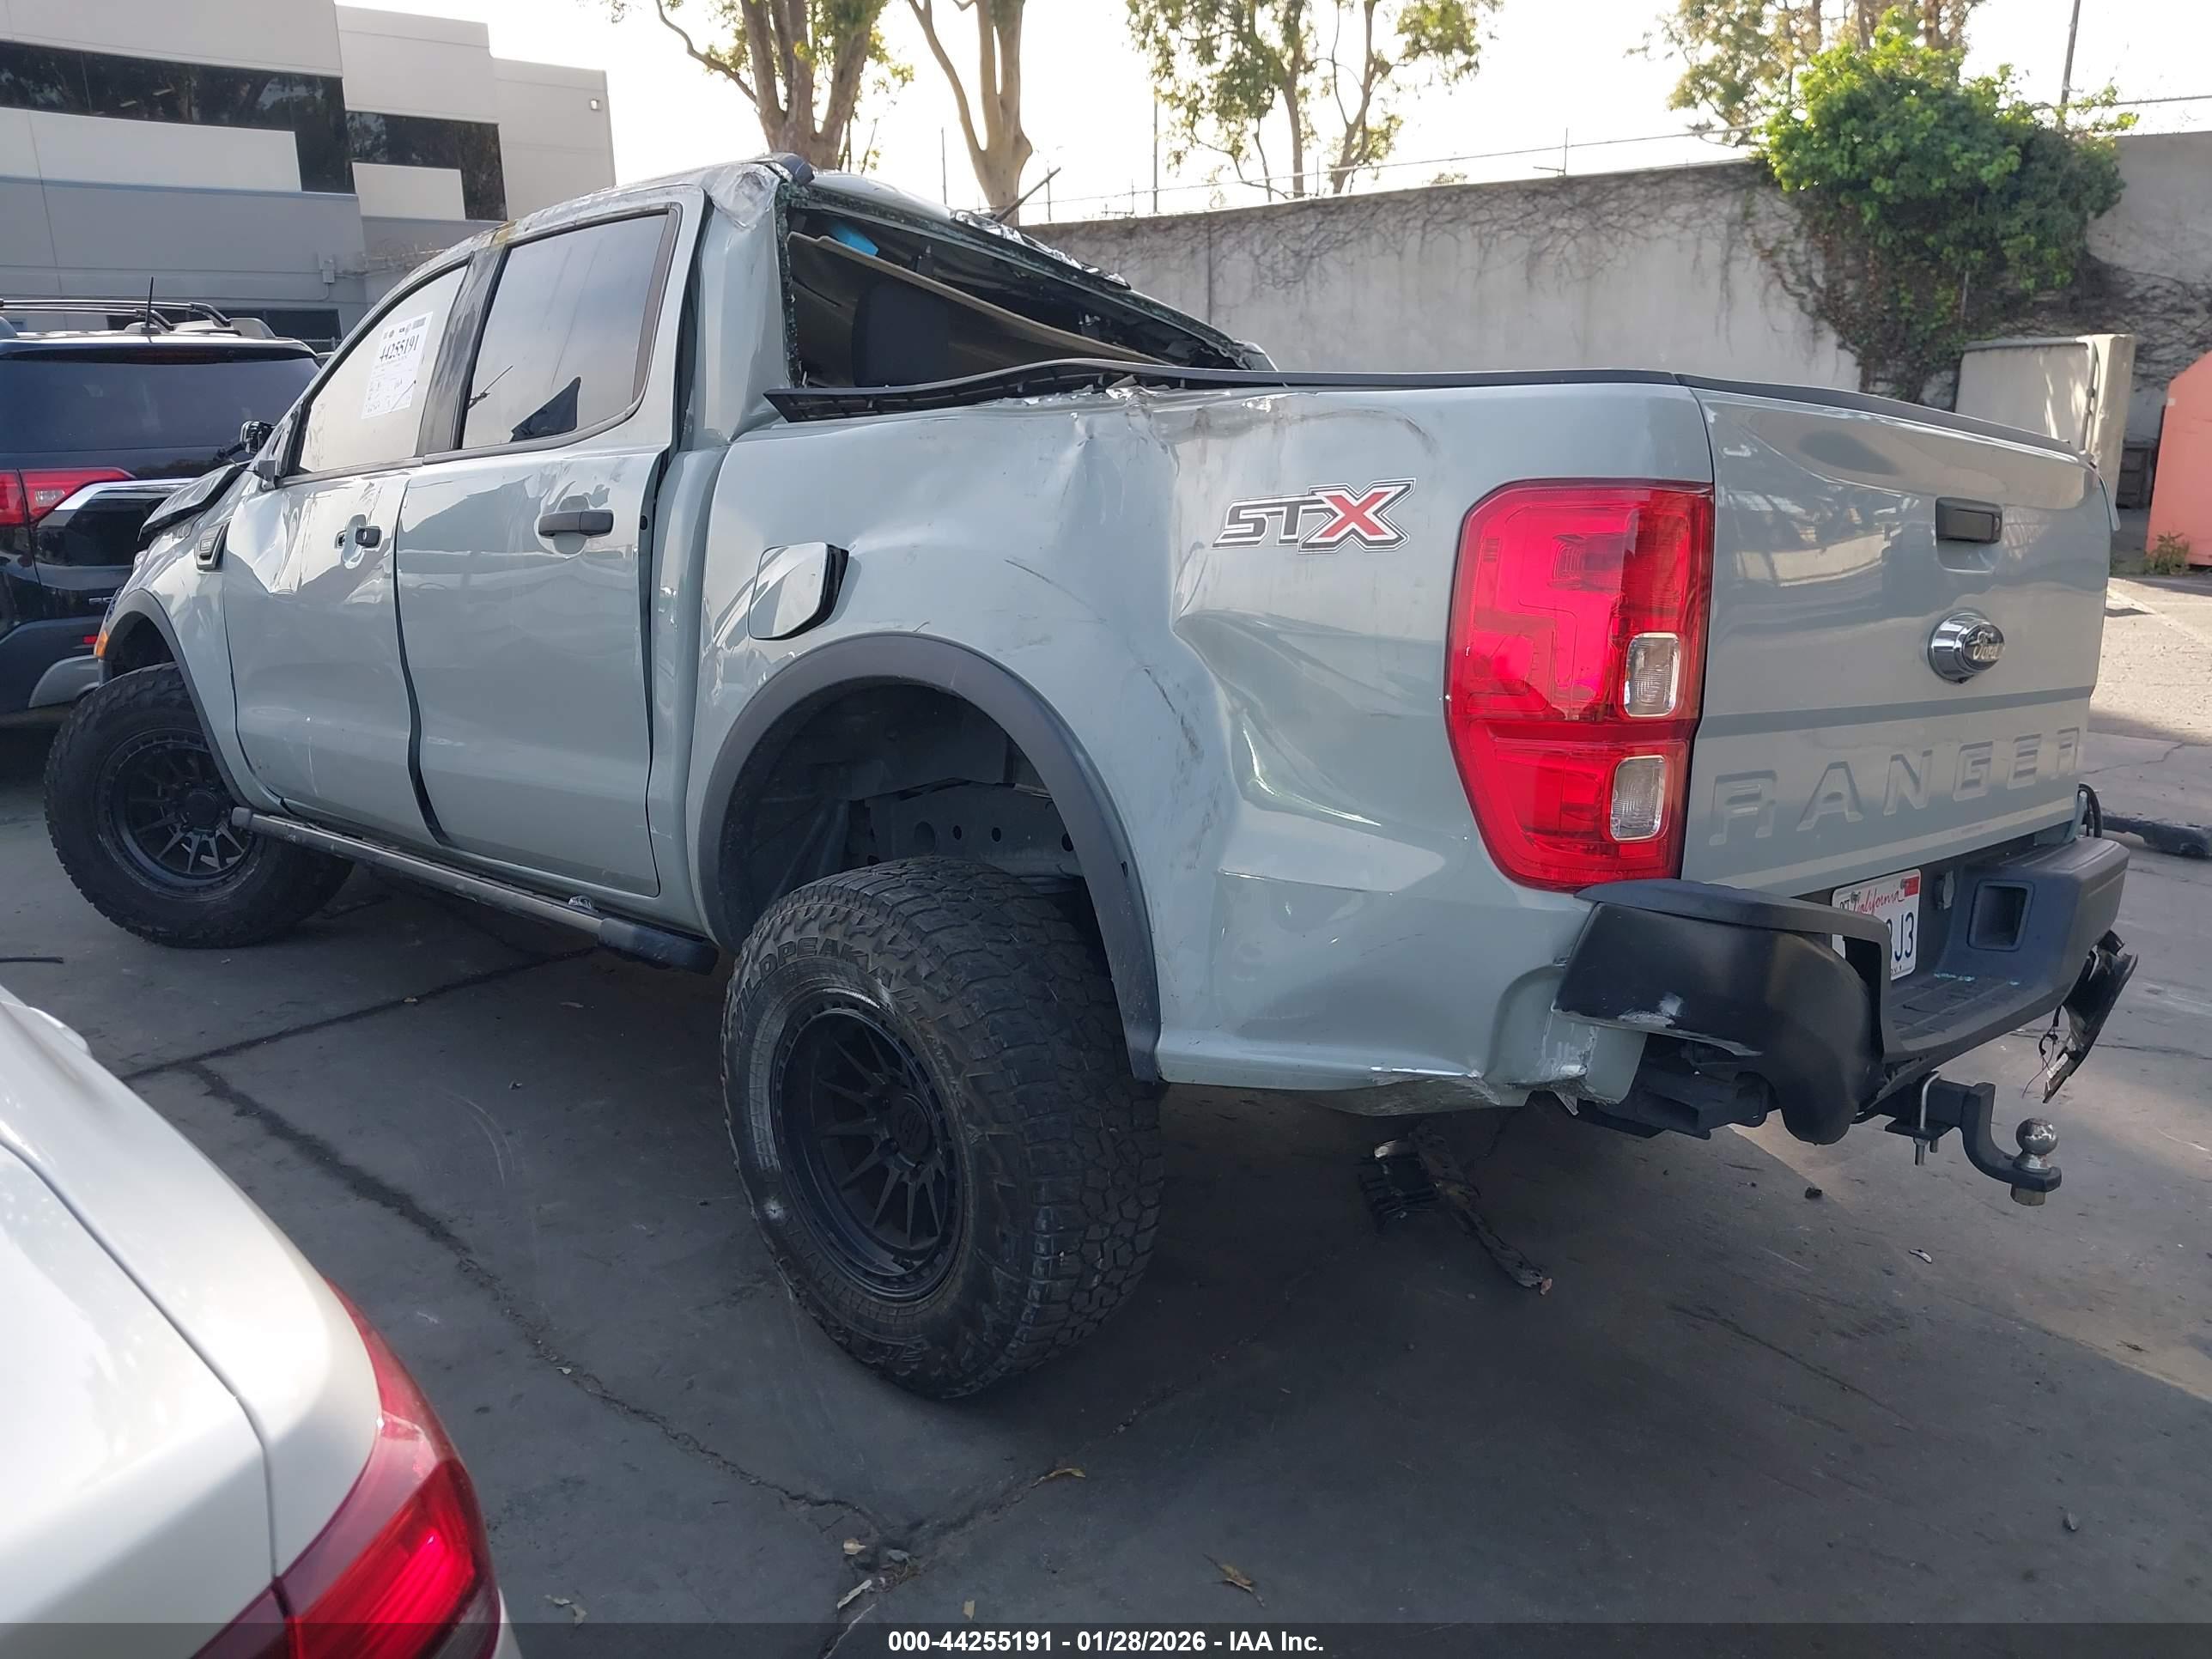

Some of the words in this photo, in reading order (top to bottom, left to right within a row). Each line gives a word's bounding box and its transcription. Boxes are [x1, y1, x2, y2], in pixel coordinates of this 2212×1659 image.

[380, 334, 420, 362] 44255191
[1212, 477, 1417, 554] STX
[1708, 727, 2081, 845] RANGER
